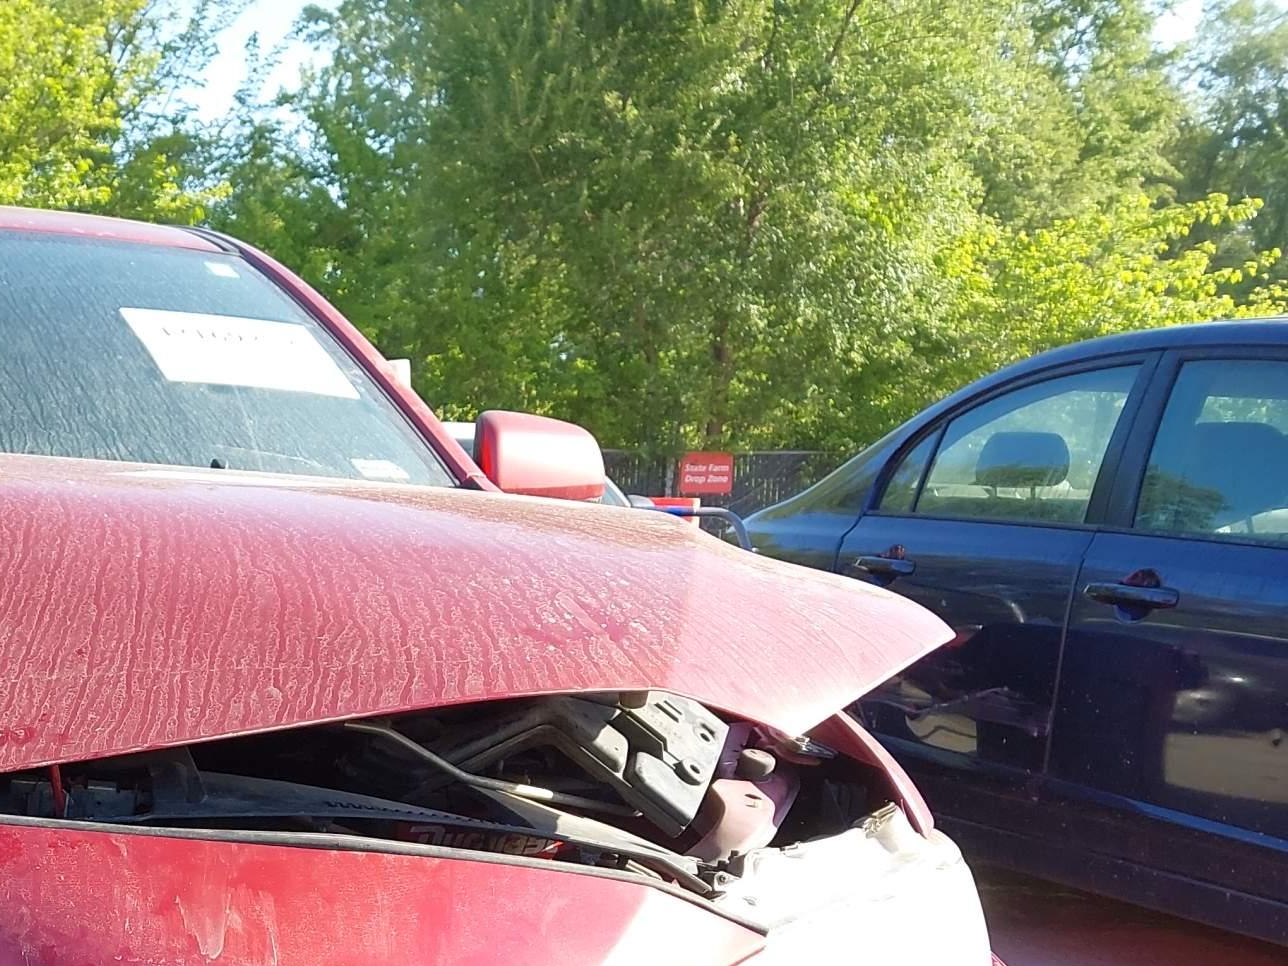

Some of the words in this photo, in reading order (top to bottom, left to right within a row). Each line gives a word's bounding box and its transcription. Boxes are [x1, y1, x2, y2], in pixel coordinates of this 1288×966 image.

[684, 463, 707, 472] State
[708, 463, 730, 472] Farm
[684, 475, 706, 484] Drop
[707, 475, 729, 483] Zone
